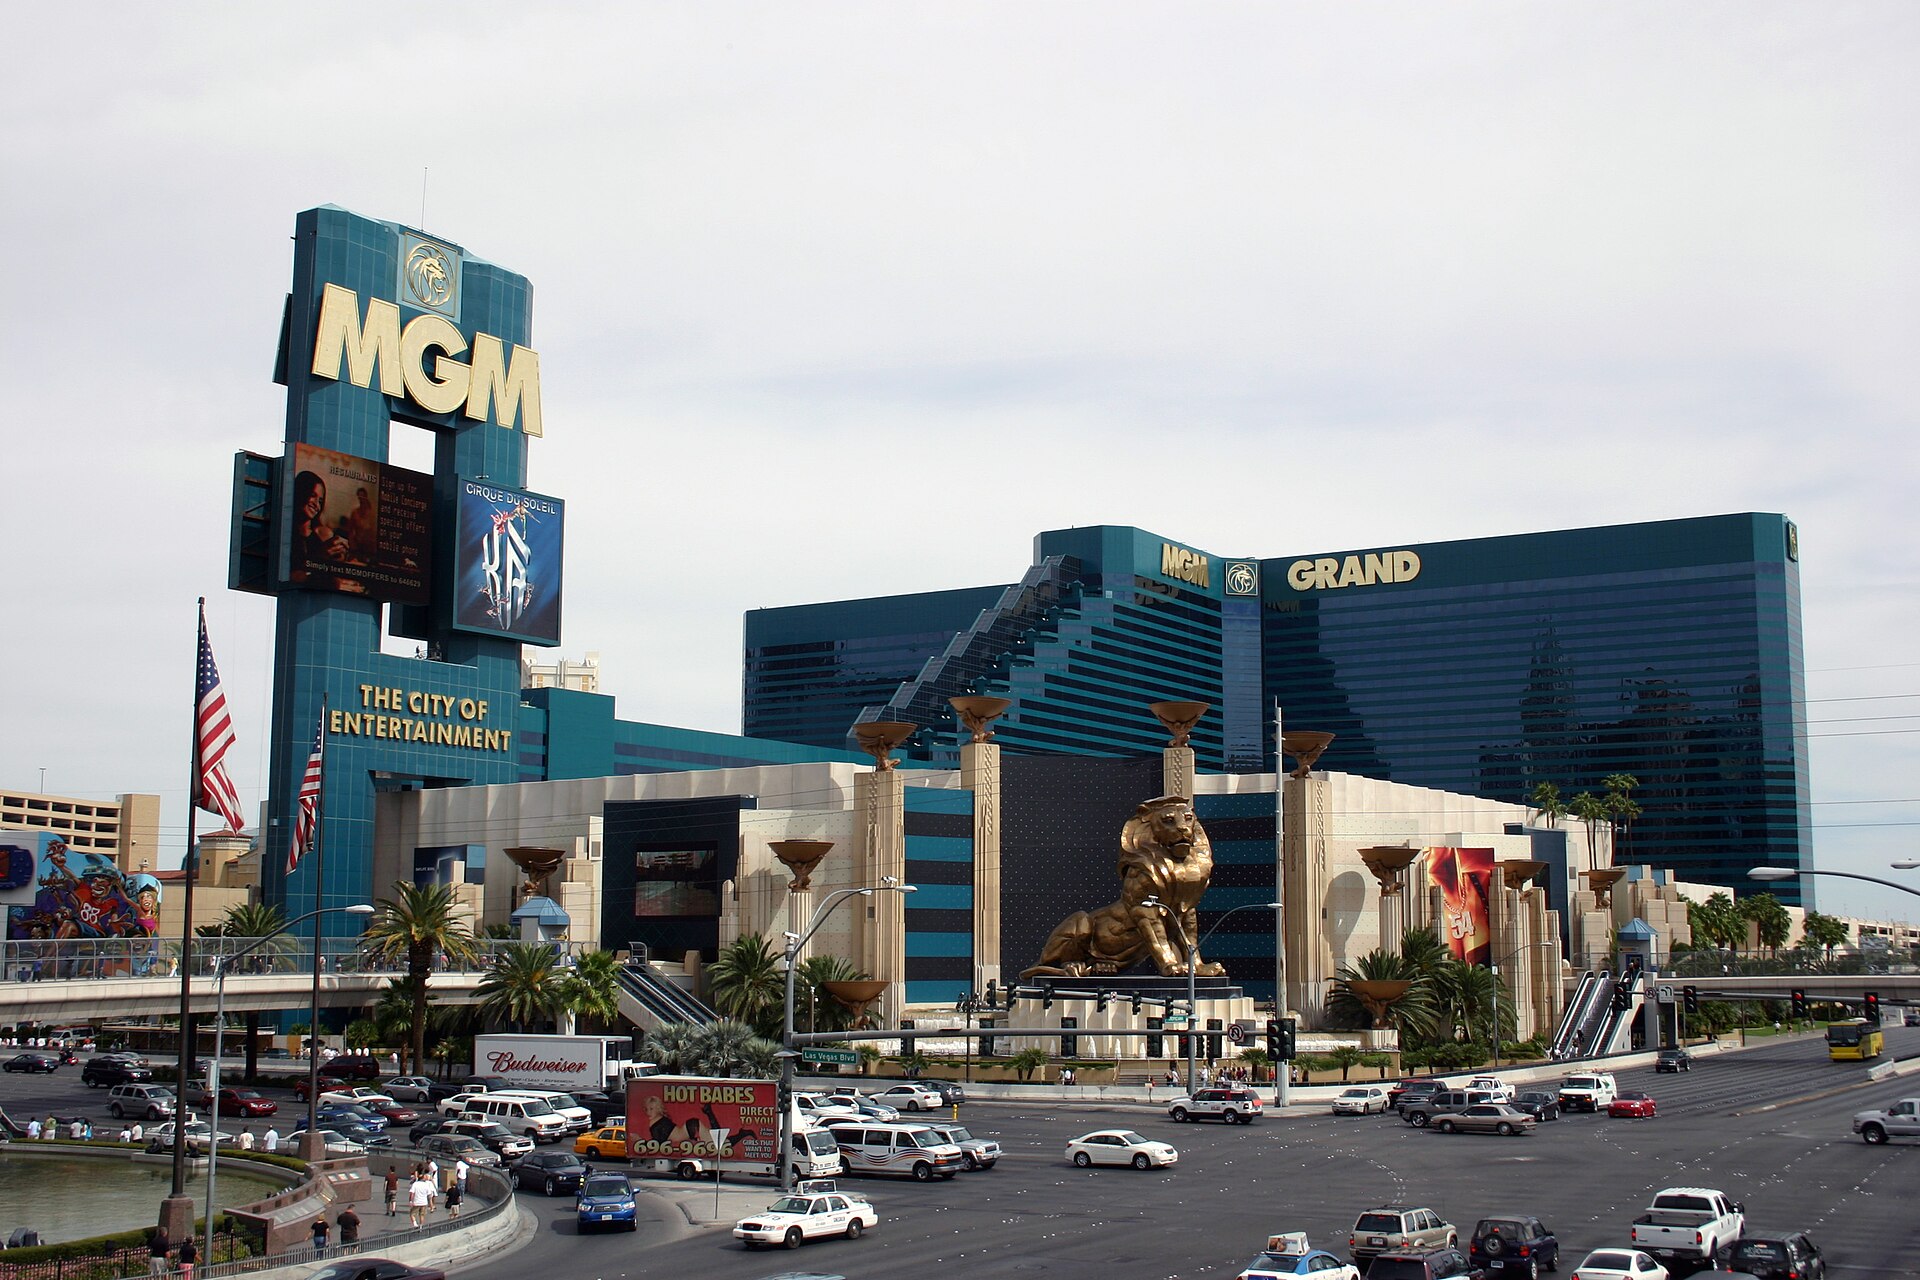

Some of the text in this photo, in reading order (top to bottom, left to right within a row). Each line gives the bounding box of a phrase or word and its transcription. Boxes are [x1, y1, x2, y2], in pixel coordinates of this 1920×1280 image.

[311, 282, 543, 438] MGM
[329, 465, 377, 484] RESTAURANTS
[306, 560, 329, 573] Simply
[330, 565, 344, 574] text
[1162, 543, 1209, 588] MGM
[1287, 550, 1421, 591] GRAND
[360, 684, 488, 721] THE CITY OF
[330, 710, 512, 751] ENTERTAINMENT
[1448, 911, 1476, 940] 54
[487, 1051, 588, 1073] Budweiser
[804, 1052, 855, 1062] Las Vegas Blvd
[663, 1085, 755, 1104] HOT BABES
[739, 1116, 774, 1125] TO YOU
[740, 1106, 775, 1116] DIRECT
[633, 1140, 734, 1158] 696-9696
